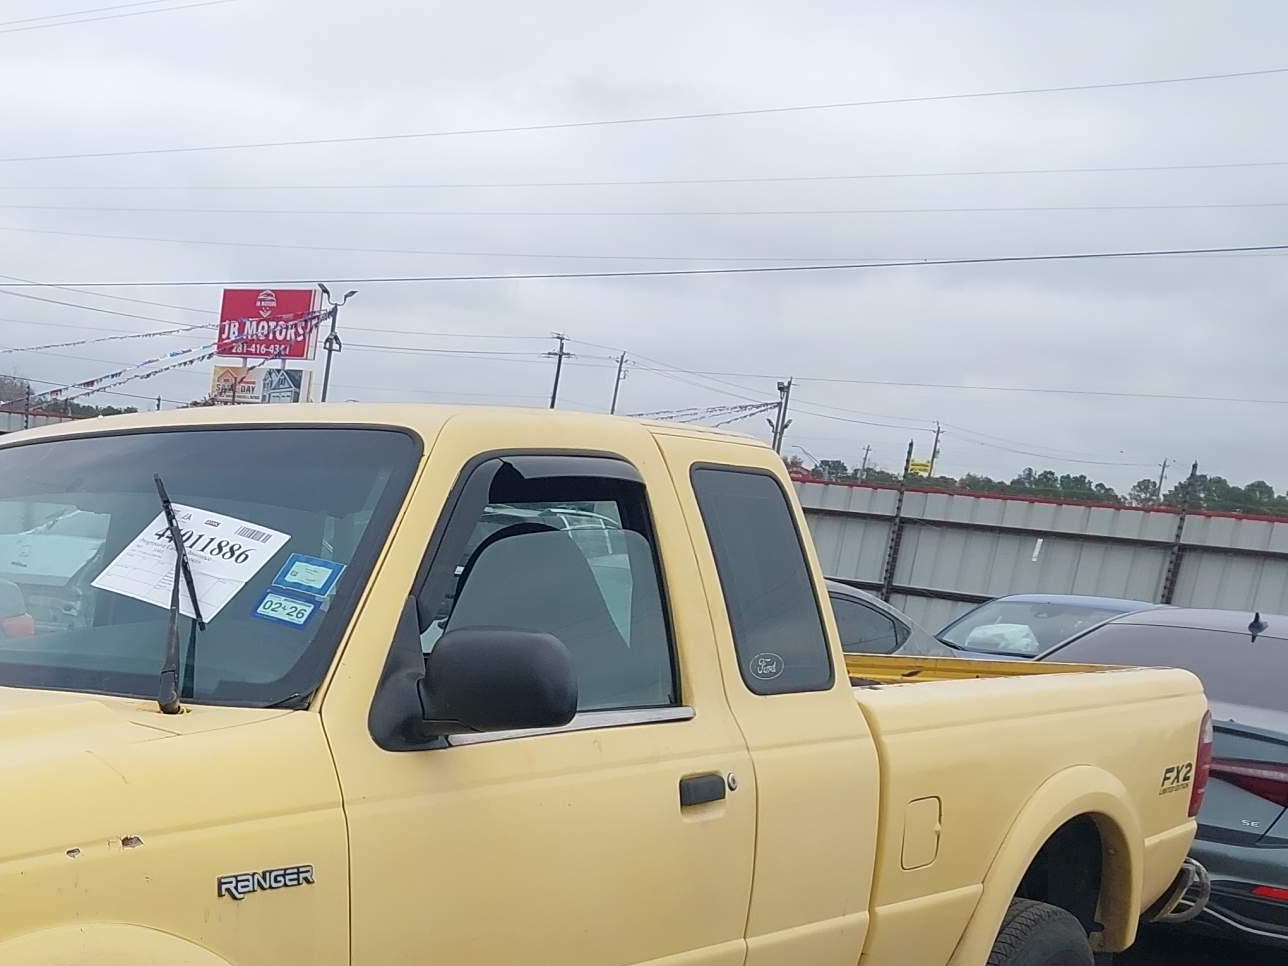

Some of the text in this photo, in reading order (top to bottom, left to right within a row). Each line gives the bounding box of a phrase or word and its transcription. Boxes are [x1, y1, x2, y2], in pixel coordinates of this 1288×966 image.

[222, 320, 306, 341] JB MOTORS
[758, 658, 776, 673] Ford
[1161, 762, 1192, 787] FX2
[217, 865, 314, 900] RANGER
